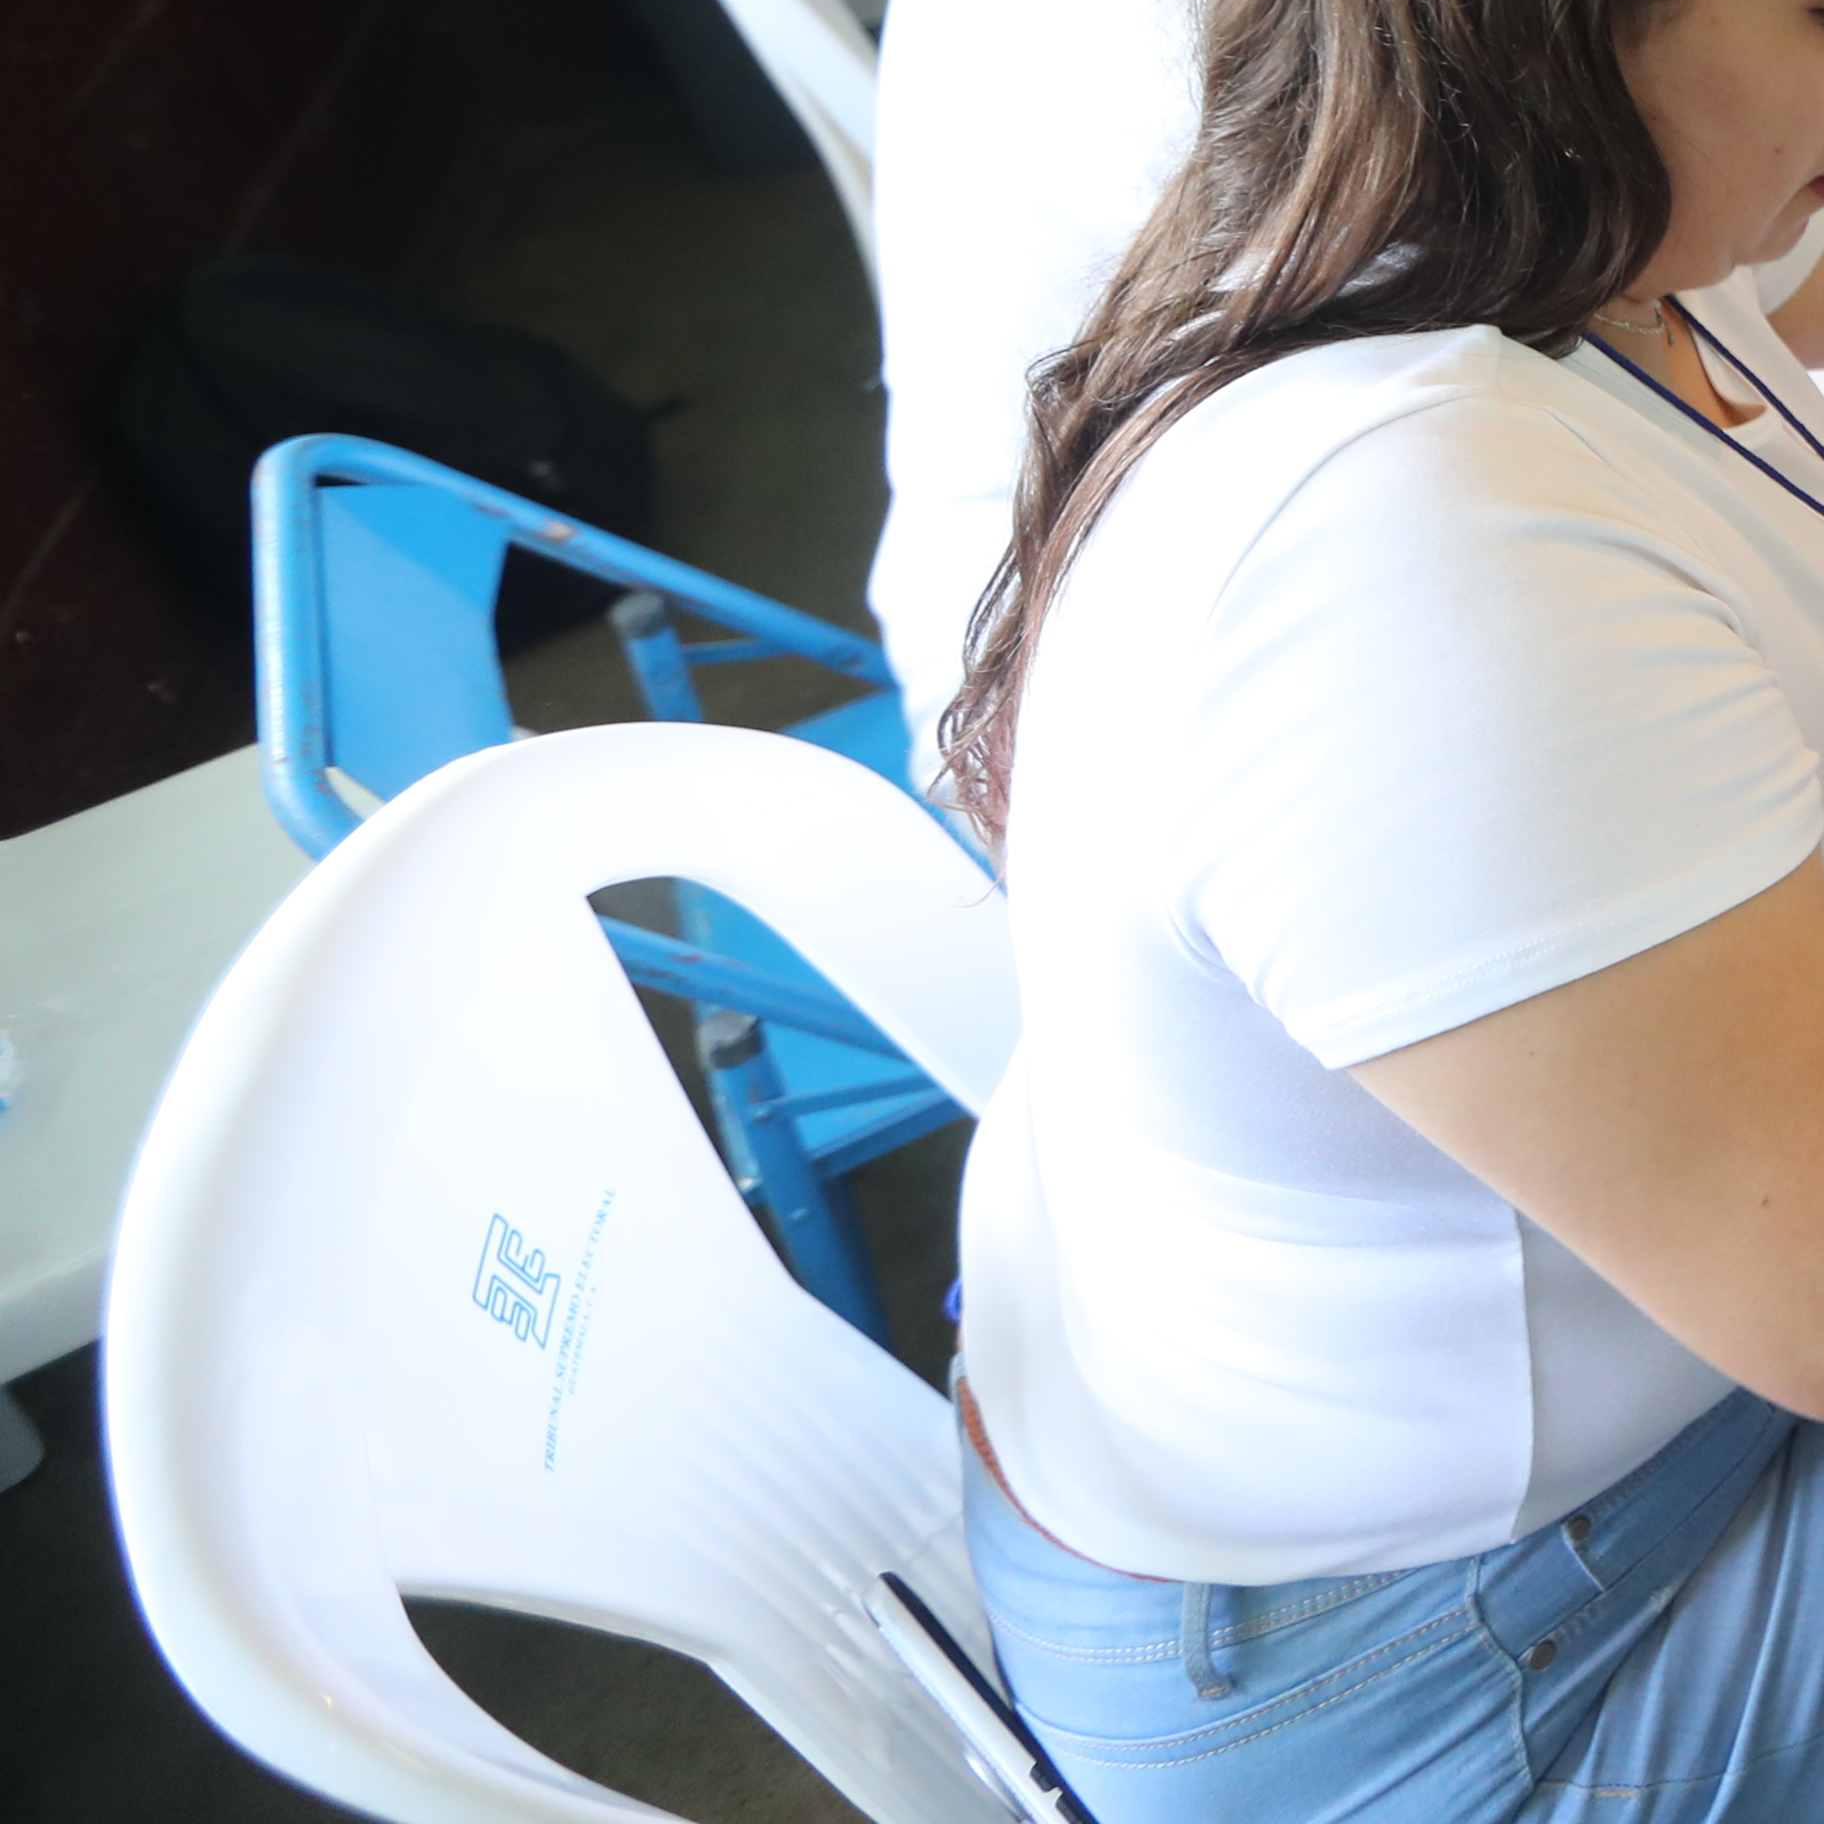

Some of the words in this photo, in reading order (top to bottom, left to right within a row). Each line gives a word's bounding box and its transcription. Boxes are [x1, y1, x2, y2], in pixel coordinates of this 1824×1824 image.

[541, 1384, 563, 1473] TRIBUNAL
[552, 1292, 583, 1382] SUPREMO
[572, 1185, 617, 1291] ELECTORAL
